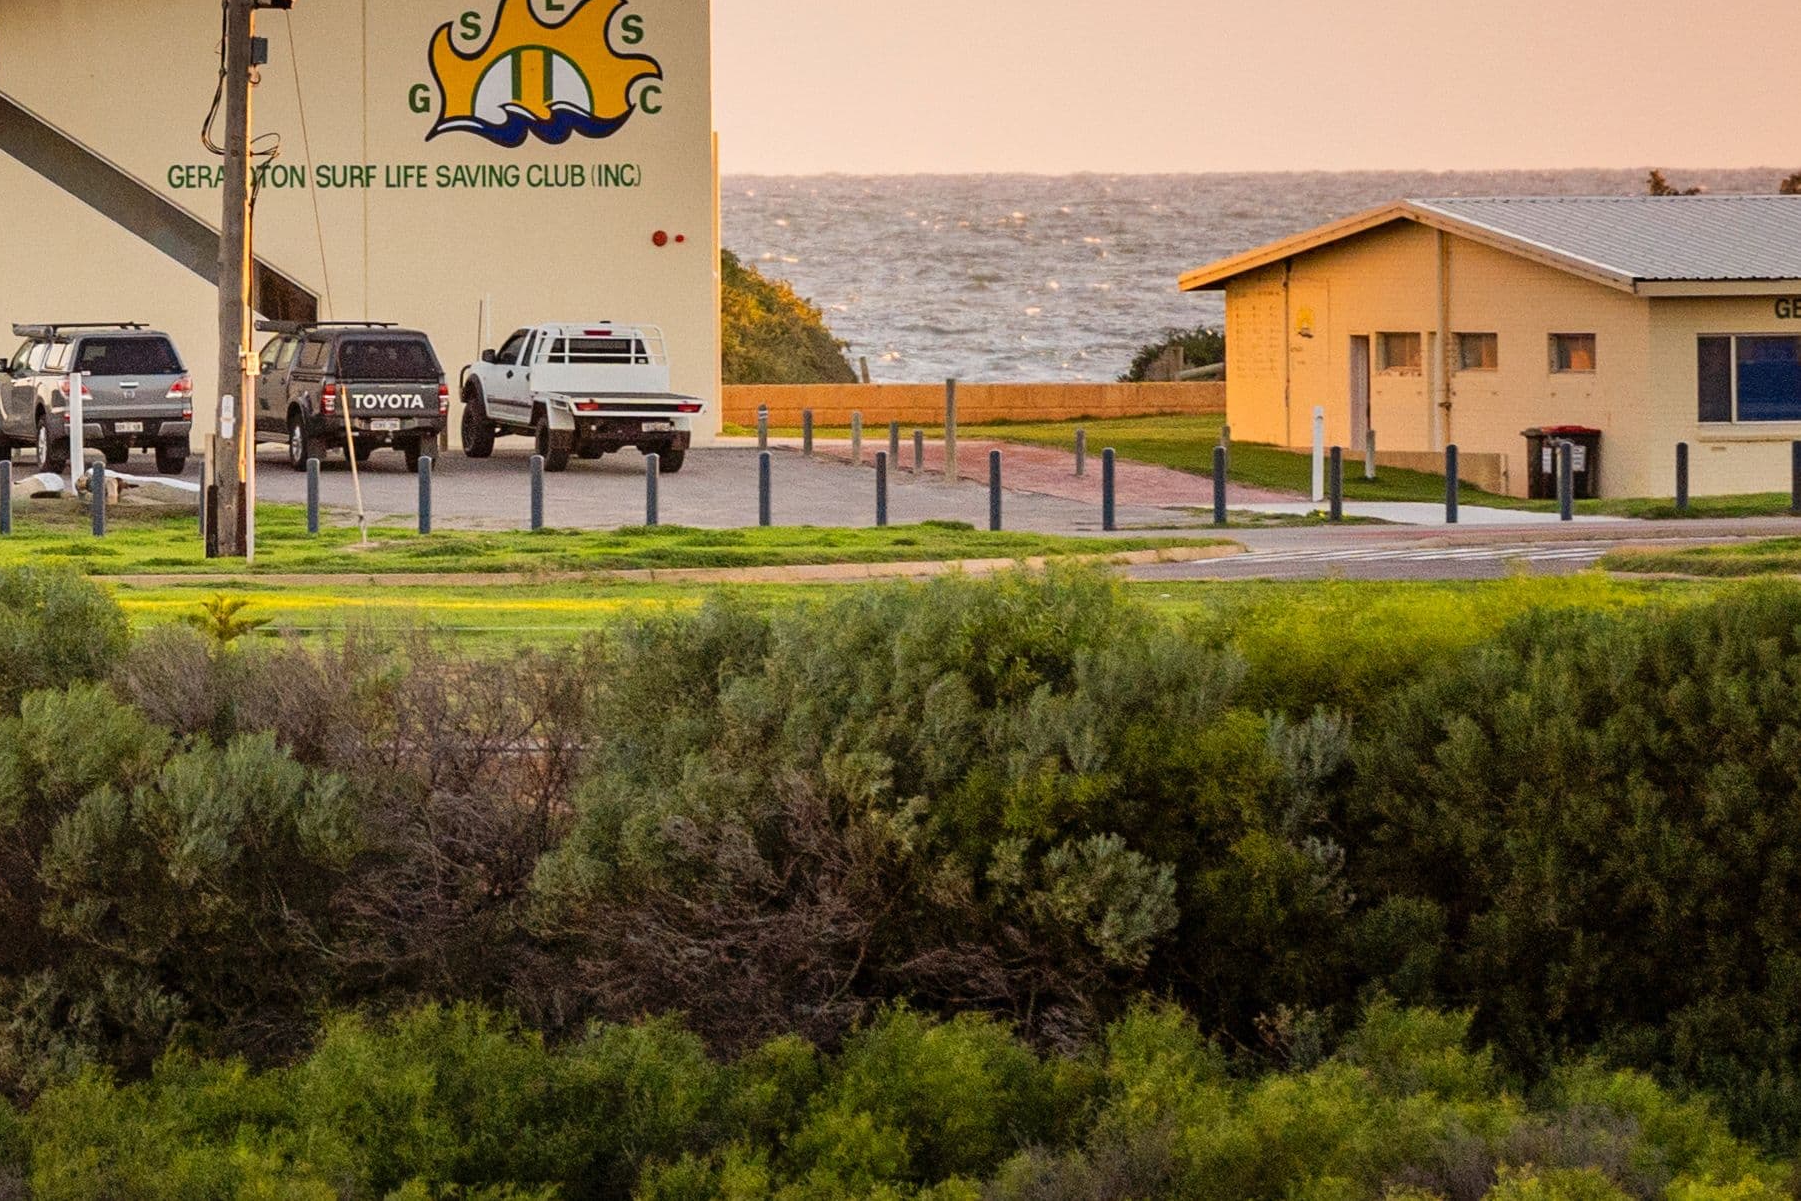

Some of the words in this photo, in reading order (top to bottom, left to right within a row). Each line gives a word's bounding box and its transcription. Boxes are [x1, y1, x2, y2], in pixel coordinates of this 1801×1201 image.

[408, 83, 431, 114] G
[459, 11, 482, 41] S
[620, 14, 644, 45] S
[639, 84, 663, 115] C
[167, 164, 305, 189] GERATON
[315, 164, 377, 189] SURF
[385, 164, 428, 188] LIFE
[435, 164, 521, 188] SAVING
[526, 163, 586, 188] CLUB
[351, 393, 425, 409] TOYOTA
